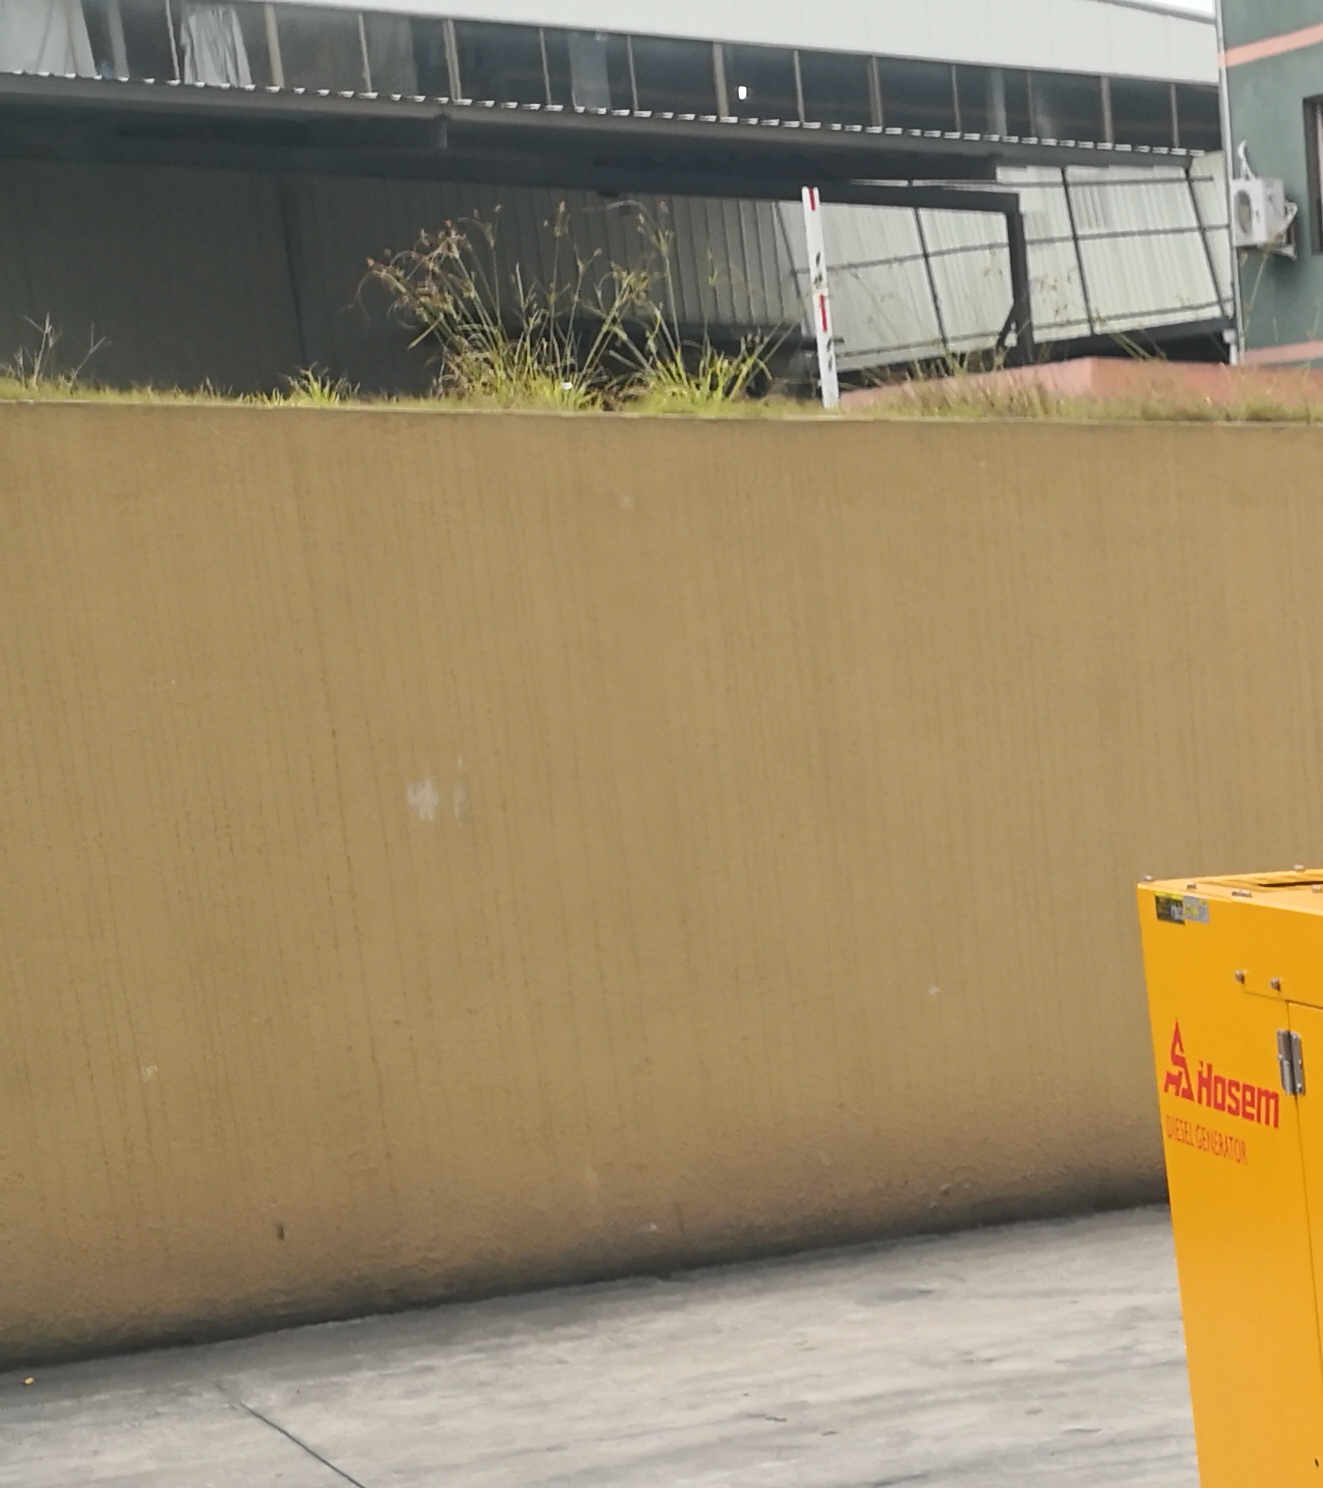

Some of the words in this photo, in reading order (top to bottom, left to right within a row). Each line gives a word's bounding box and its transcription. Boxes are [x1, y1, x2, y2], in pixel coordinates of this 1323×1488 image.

[1196, 1059, 1280, 1129] Hosem
[1165, 1114, 1195, 1146] DIESEL
[1195, 1124, 1248, 1165] GENERATOR
